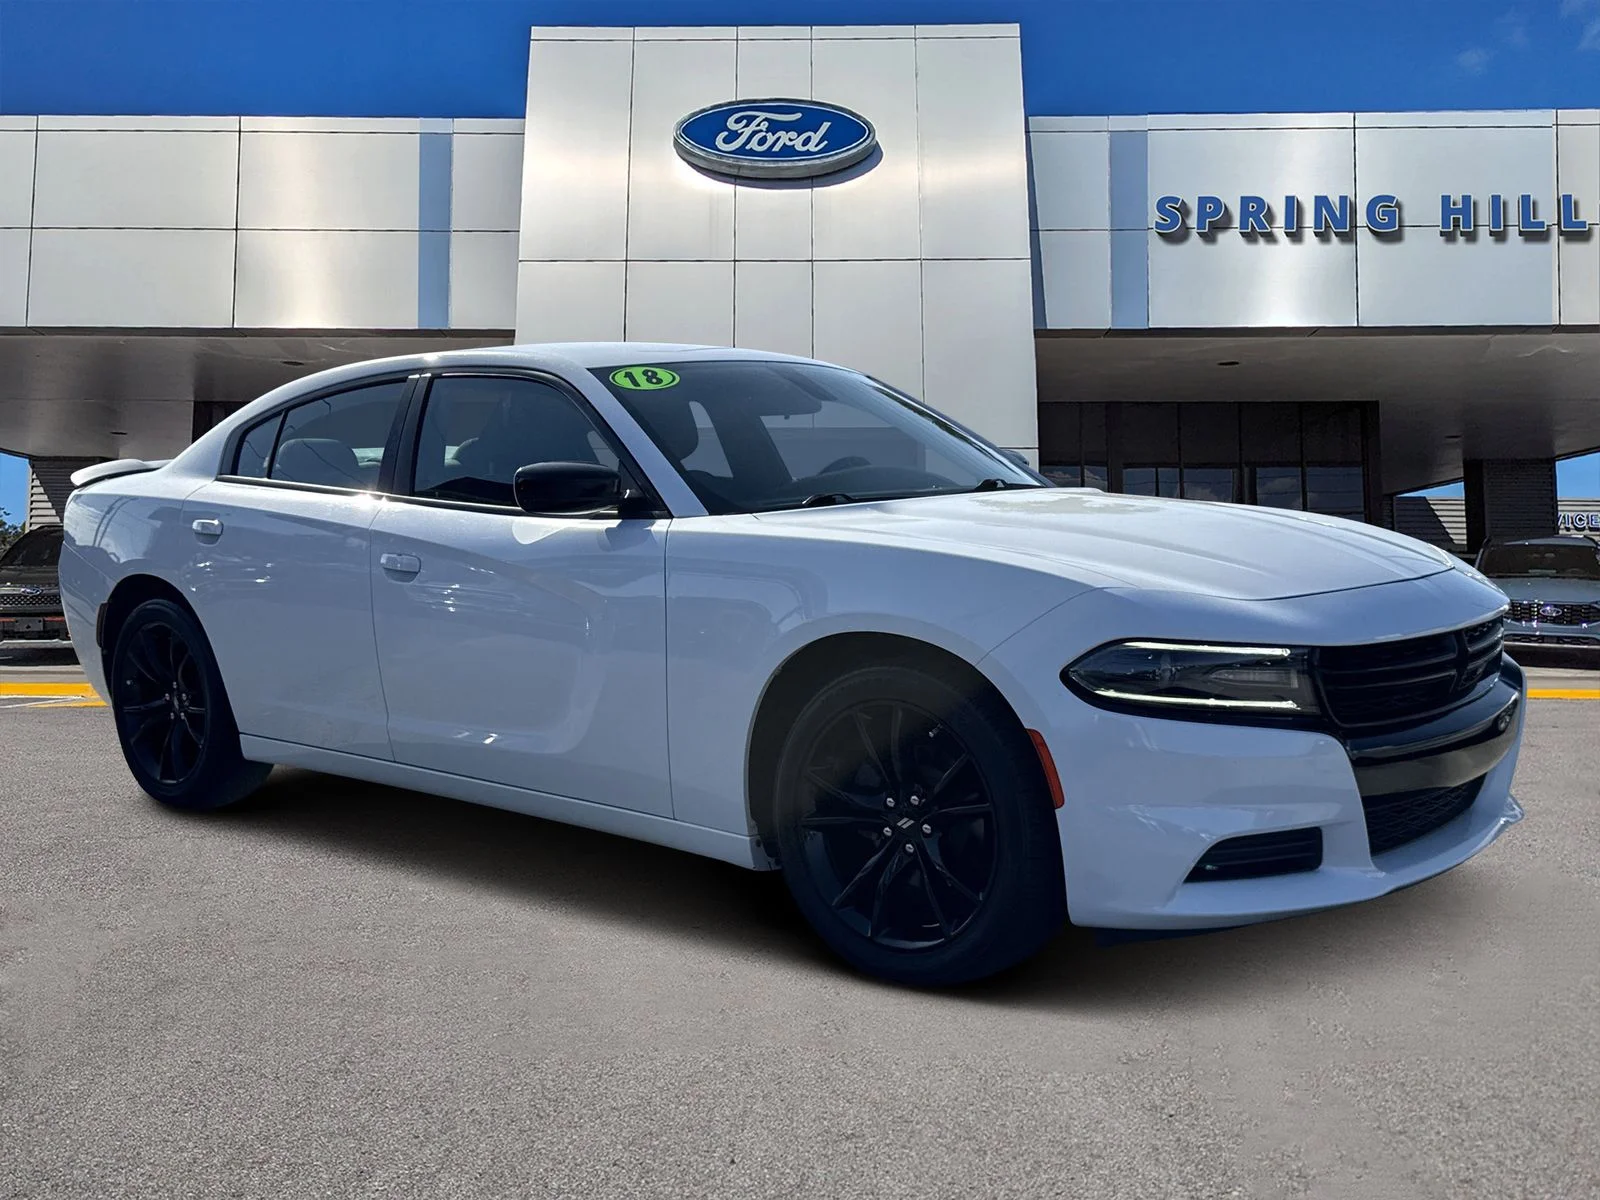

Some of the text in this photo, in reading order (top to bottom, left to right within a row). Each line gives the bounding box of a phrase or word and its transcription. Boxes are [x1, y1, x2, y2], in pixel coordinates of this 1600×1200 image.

[715, 111, 832, 152] Ford
[1153, 193, 1589, 232] SPRING HILL
[624, 369, 663, 387] 18
